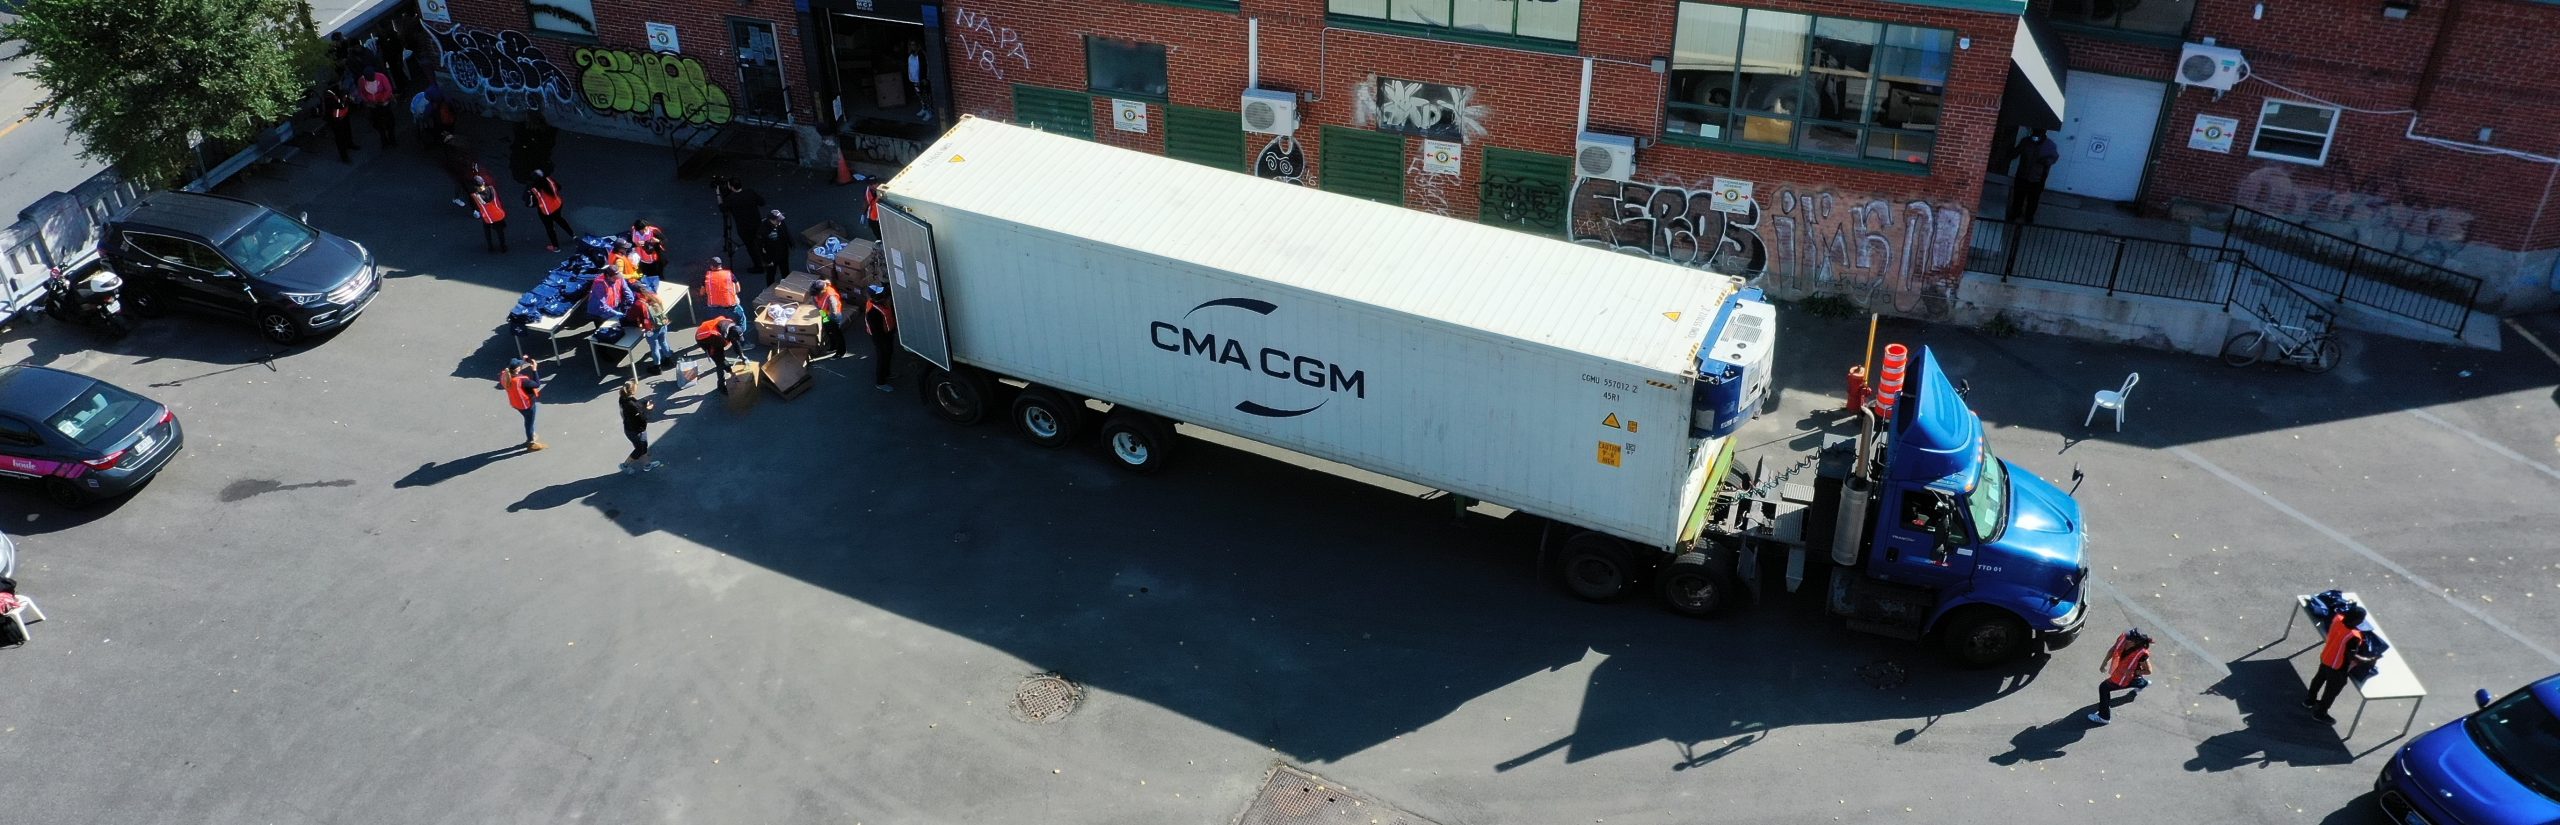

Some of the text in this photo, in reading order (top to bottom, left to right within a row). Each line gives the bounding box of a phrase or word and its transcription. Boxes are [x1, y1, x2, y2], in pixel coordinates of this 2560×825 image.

[956, 8, 1029, 69] NAPA
[1150, 320, 1365, 399] CMA CGM
[1581, 373, 1600, 384] CGMU
[1604, 378, 1630, 391] 557012
[1603, 391, 1620, 401] 45R1
